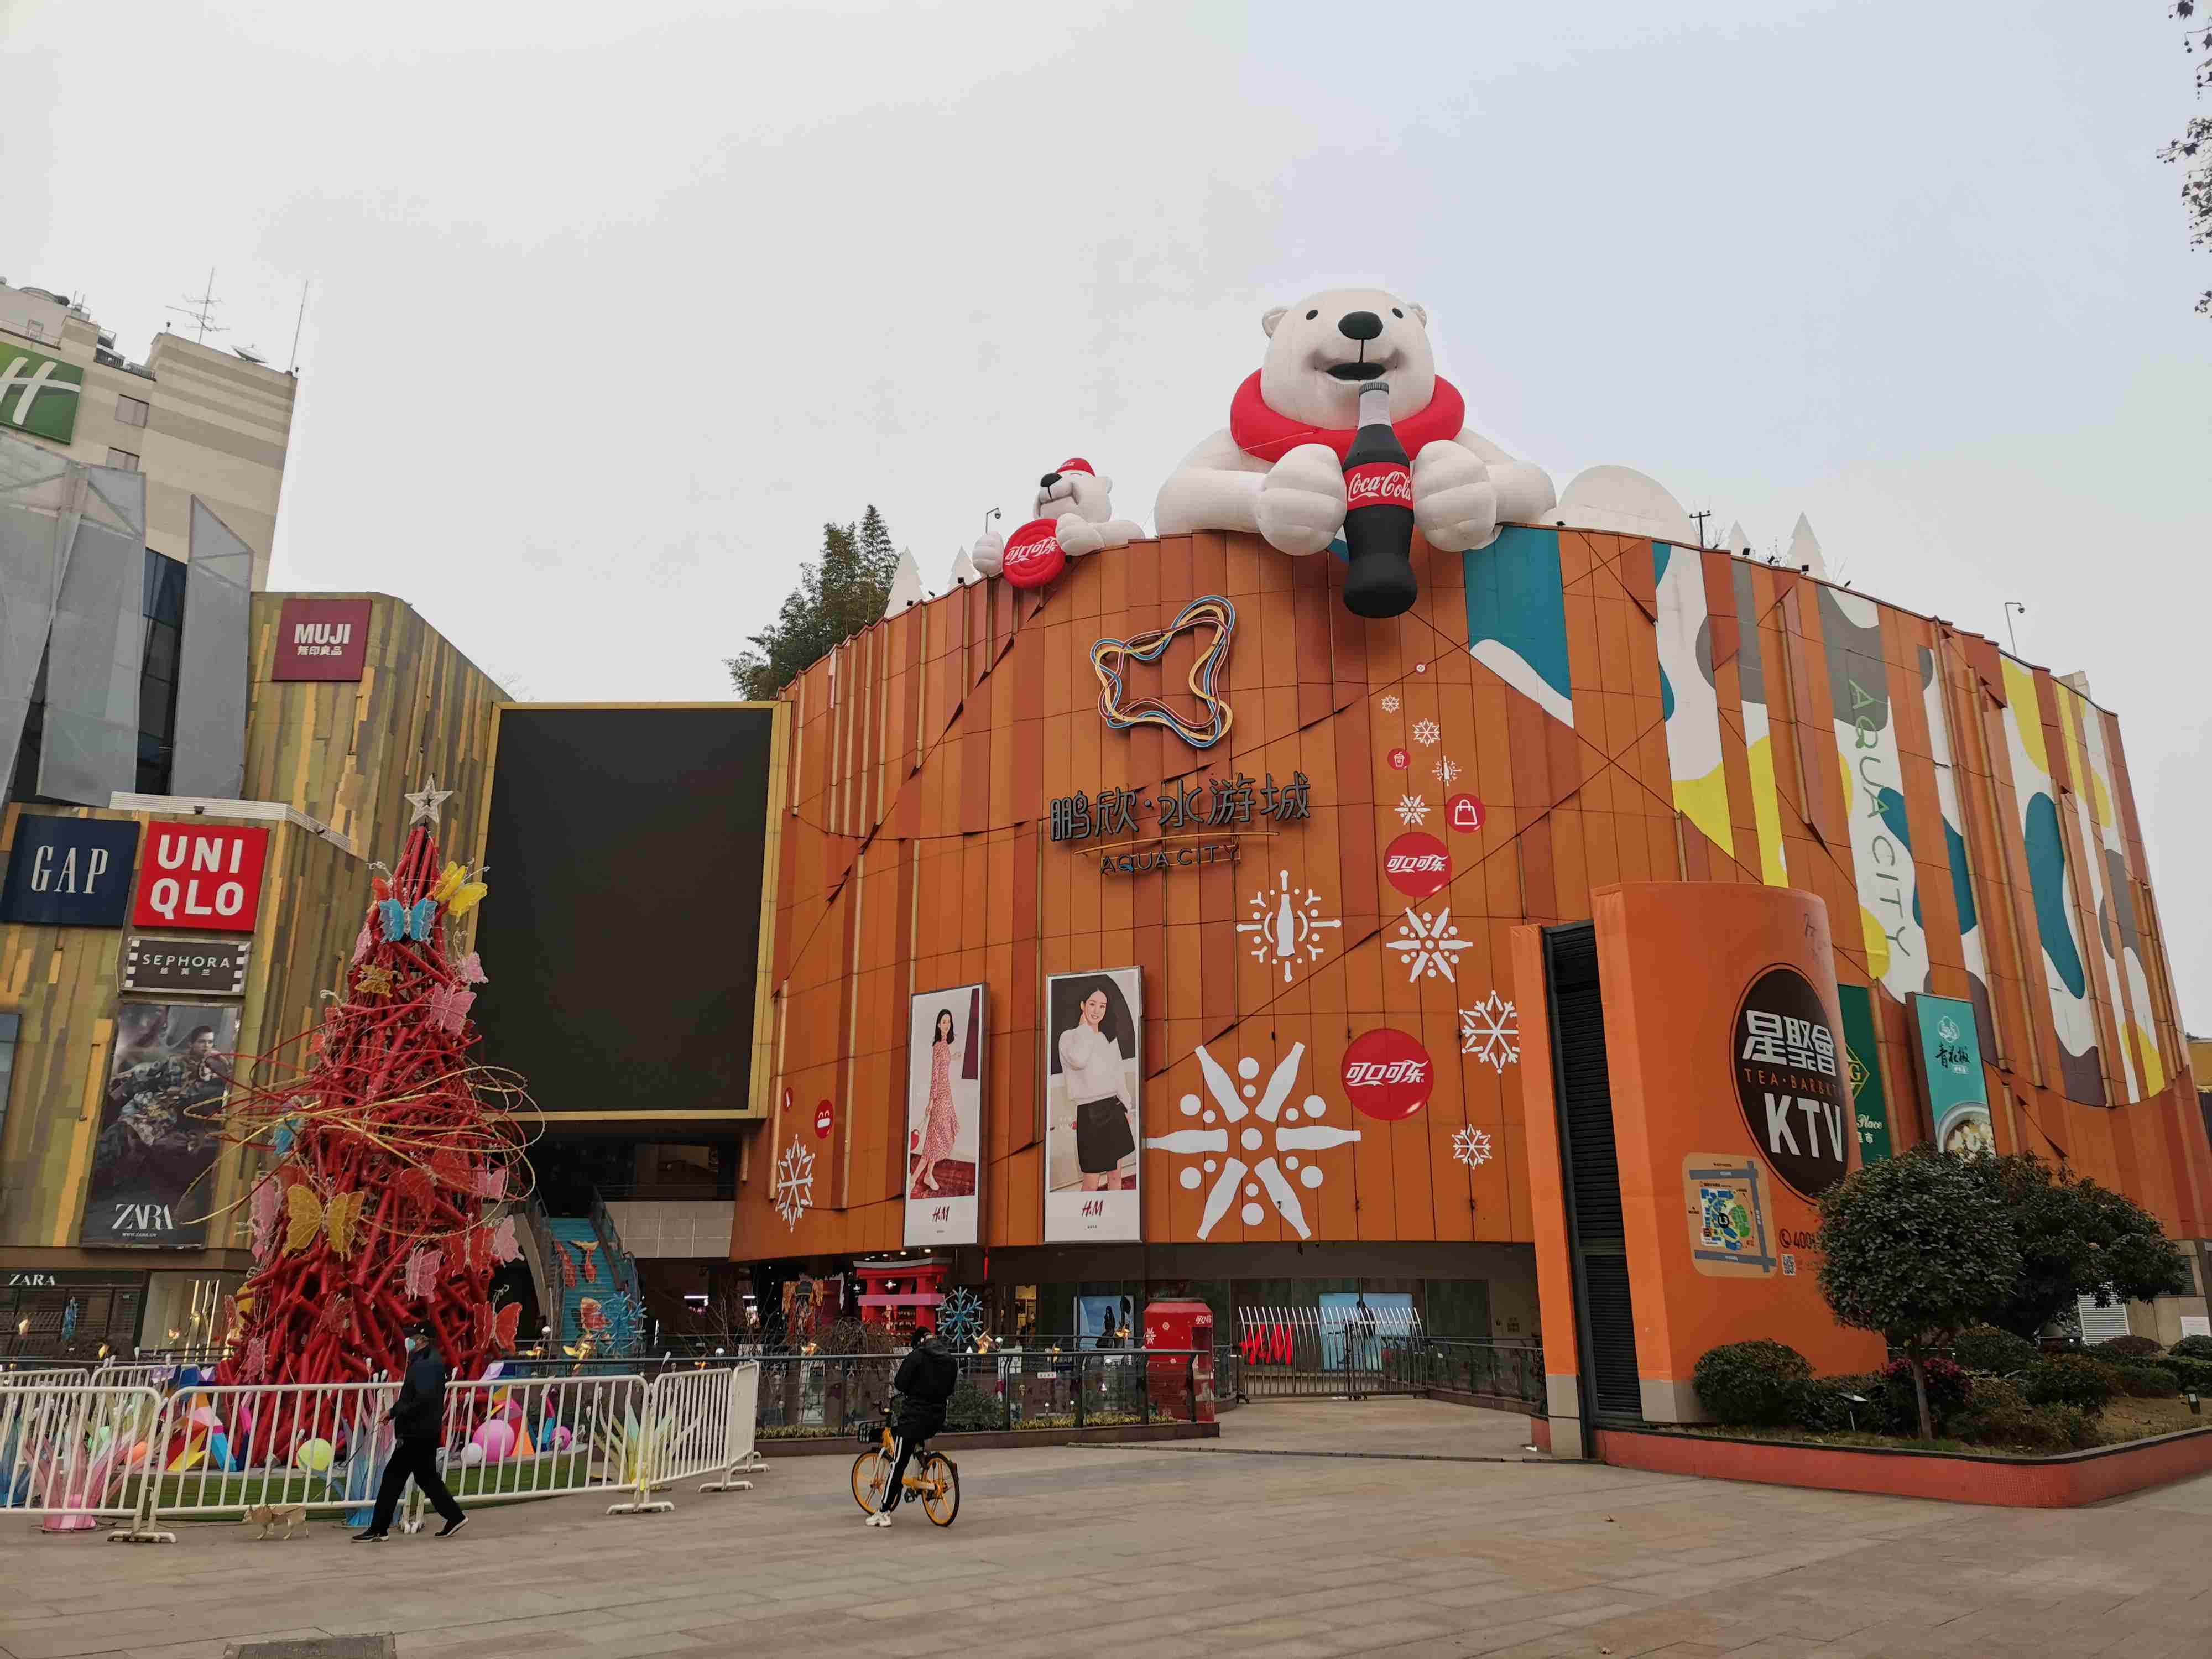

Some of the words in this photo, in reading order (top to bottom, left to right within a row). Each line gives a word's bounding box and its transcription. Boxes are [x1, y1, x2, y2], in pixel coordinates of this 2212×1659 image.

[1348, 471, 1411, 502] Coca-Cola
[1004, 536, 1058, 565] 可口可乐
[294, 623, 351, 644] MUJI
[1849, 679, 1889, 818] AQUA
[1871, 835, 1910, 957] CITY
[157, 834, 244, 874] UNI
[1387, 854, 1448, 873] 可口可乐
[30, 845, 108, 894] GAP
[150, 878, 244, 920] QLO
[142, 954, 229, 968] SEPHORA
[1345, 1060, 1429, 1086] 可口可乐
[1764, 1093, 1843, 1162] KTV
[111, 1203, 173, 1230] ZARA
[9, 1274, 55, 1286] ZARA
